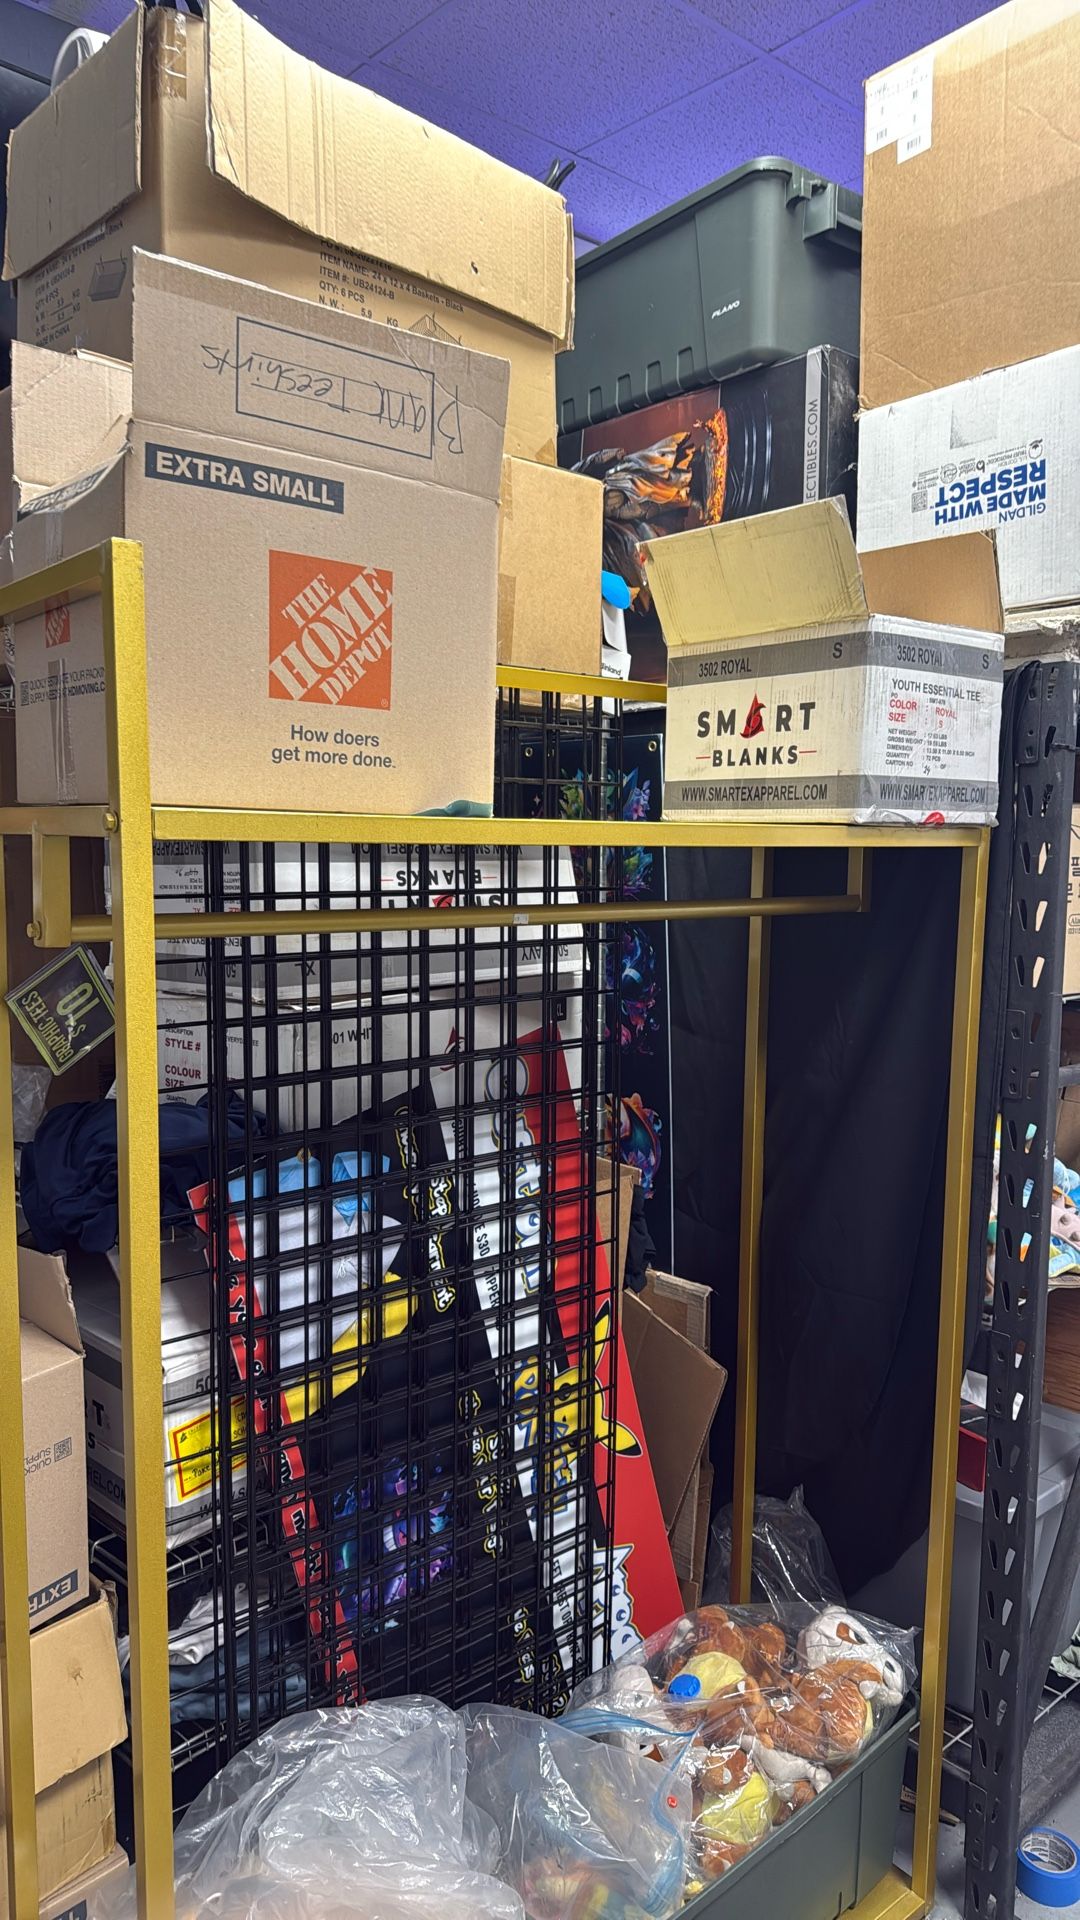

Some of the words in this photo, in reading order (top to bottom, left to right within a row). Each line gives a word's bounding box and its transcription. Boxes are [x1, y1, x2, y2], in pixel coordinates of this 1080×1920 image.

[319, 280, 339, 294] QTY:
[340, 288, 347, 298] 6
[348, 290, 365, 304] PCS
[320, 252, 341, 266] ITEM
[342, 259, 369, 277] NAME:
[372, 270, 382, 280] 24
[390, 277, 399, 289] 12
[405, 283, 411, 293] 4
[412, 286, 440, 305] Baskets
[445, 298, 465, 313] Black
[320, 265, 340, 281] ITEM
[352, 277, 395, 301] UB24124-B
[361, 307, 373, 319] 5.9
[386, 316, 399, 328] KG
[156, 450, 246, 489] EXTRA
[253, 470, 336, 506] SMALL
[935, 459, 1046, 508] RESPECT
[986, 482, 1046, 513] MADE
[934, 499, 984, 526] WITH
[999, 502, 1047, 523] GILDAN
[281, 573, 336, 629] THE
[269, 566, 393, 701] HOME
[832, 642, 843, 659] S
[897, 645, 916, 663] 3502
[318, 621, 393, 705] DEPOT
[699, 662, 718, 677] 3502
[721, 657, 752, 675] ROYAL
[982, 654, 990, 670] S
[892, 679, 921, 693] YOUTH
[923, 683, 965, 699] ESSENTIAL
[966, 690, 981, 701] TEE
[889, 699, 917, 710] COLOR
[935, 707, 957, 719] ROYAL
[888, 712, 906, 723] SIZE
[939, 720, 944, 729] S
[291, 724, 329, 743] How
[333, 729, 380, 748] doers
[898, 729, 917, 737] WEIGHT
[905, 737, 923, 745] WEIGHT
[271, 746, 300, 764] get
[305, 749, 348, 765] more
[352, 751, 396, 769] done.
[712, 745, 798, 767] BLANKS
[887, 744, 913, 752] DIMENSION
[681, 784, 828, 802] WWW.SMARTEXAPPAREL.COM
[21, 990, 49, 1024] TEES
[38, 1014, 75, 1064] GRAPHIC
[165, 1037, 193, 1050] STYLE
[165, 1064, 202, 1080] COLOUR
